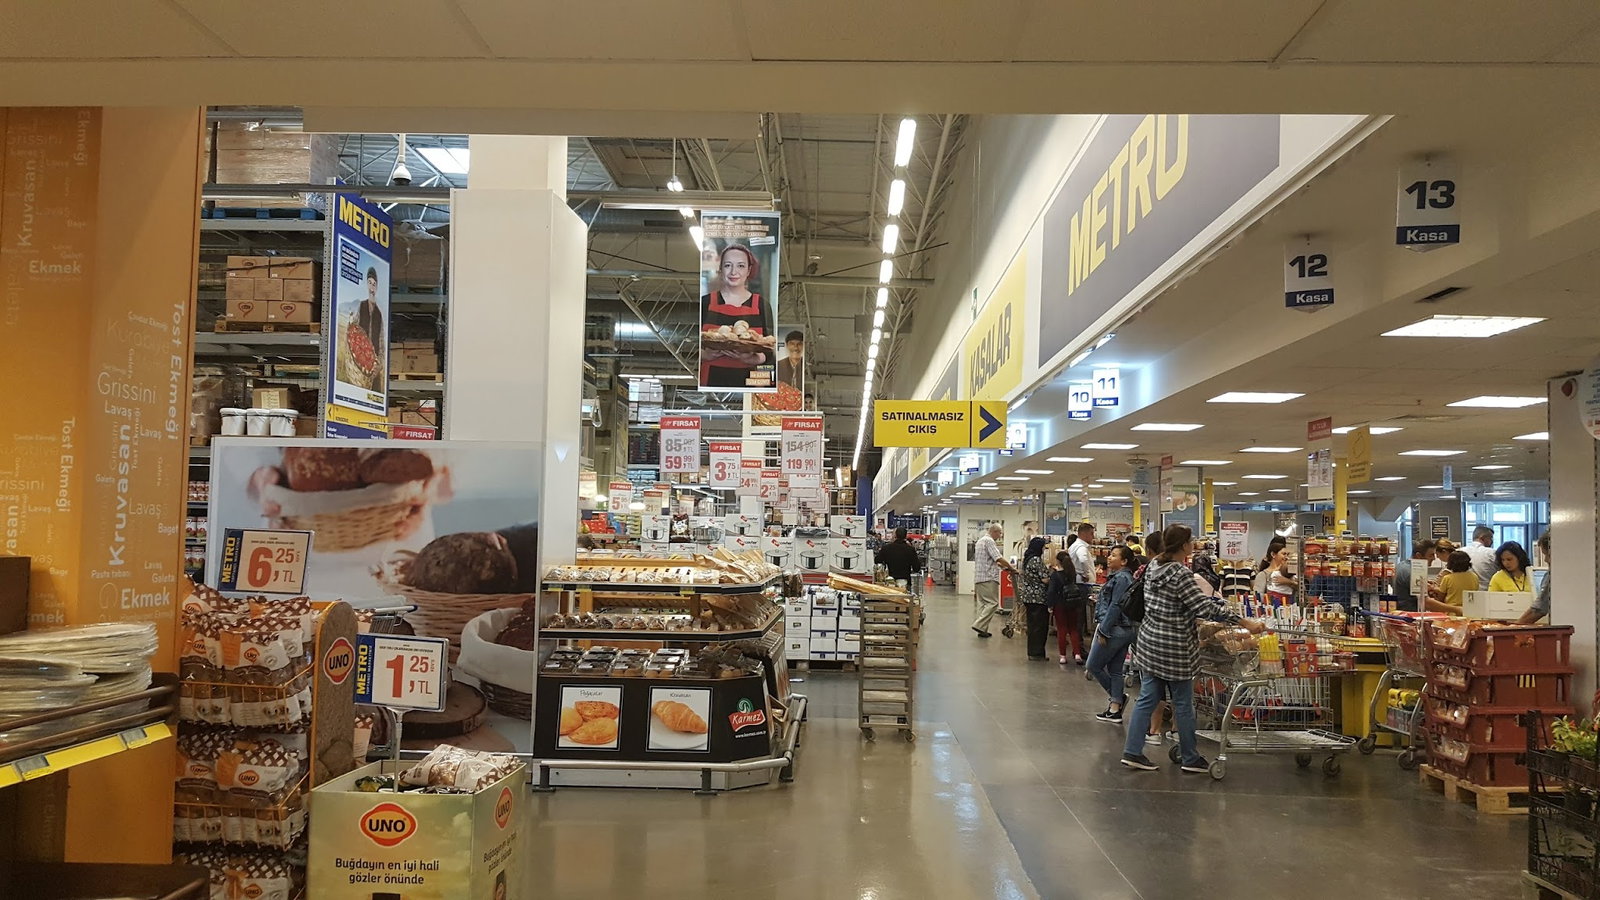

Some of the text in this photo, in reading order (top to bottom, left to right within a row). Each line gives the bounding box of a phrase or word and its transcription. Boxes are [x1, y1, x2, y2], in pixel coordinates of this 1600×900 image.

[17, 159, 37, 246] Kruvasan
[1405, 179, 1456, 210] 13
[1068, 114, 1189, 297] METRO
[339, 195, 390, 249] METRO
[1406, 229, 1448, 242] Kasa
[29, 260, 82, 274] Ekmek
[1289, 254, 1328, 278] 12
[1296, 292, 1329, 304] Kasa
[172, 301, 185, 348] Tost
[969, 302, 1012, 399] KASALAR
[97, 371, 156, 404] Grissini
[1098, 377, 1116, 390] 11
[1072, 391, 1090, 403] 10
[672, 420, 699, 428] FIRSAT
[794, 421, 820, 429] FIRSAT
[881, 411, 964, 422] SATINALMASIZ
[404, 431, 433, 439] FIRSAT
[56, 417, 75, 512] Tost Ekmeği
[0, 480, 45, 491] rissini
[109, 424, 131, 566] Kruvasan
[221, 537, 236, 583] METRO
[274, 547, 295, 564] 25
[121, 586, 170, 610] Ekmek
[329, 653, 349, 670] UNO
[356, 644, 369, 695] METRO
[409, 655, 429, 673] 25
[732, 713, 761, 724] Karmez
[368, 819, 406, 833] UNO
[335, 858, 440, 872] Buğdayın en iyi hali
[349, 872, 425, 885] gözler önünde
